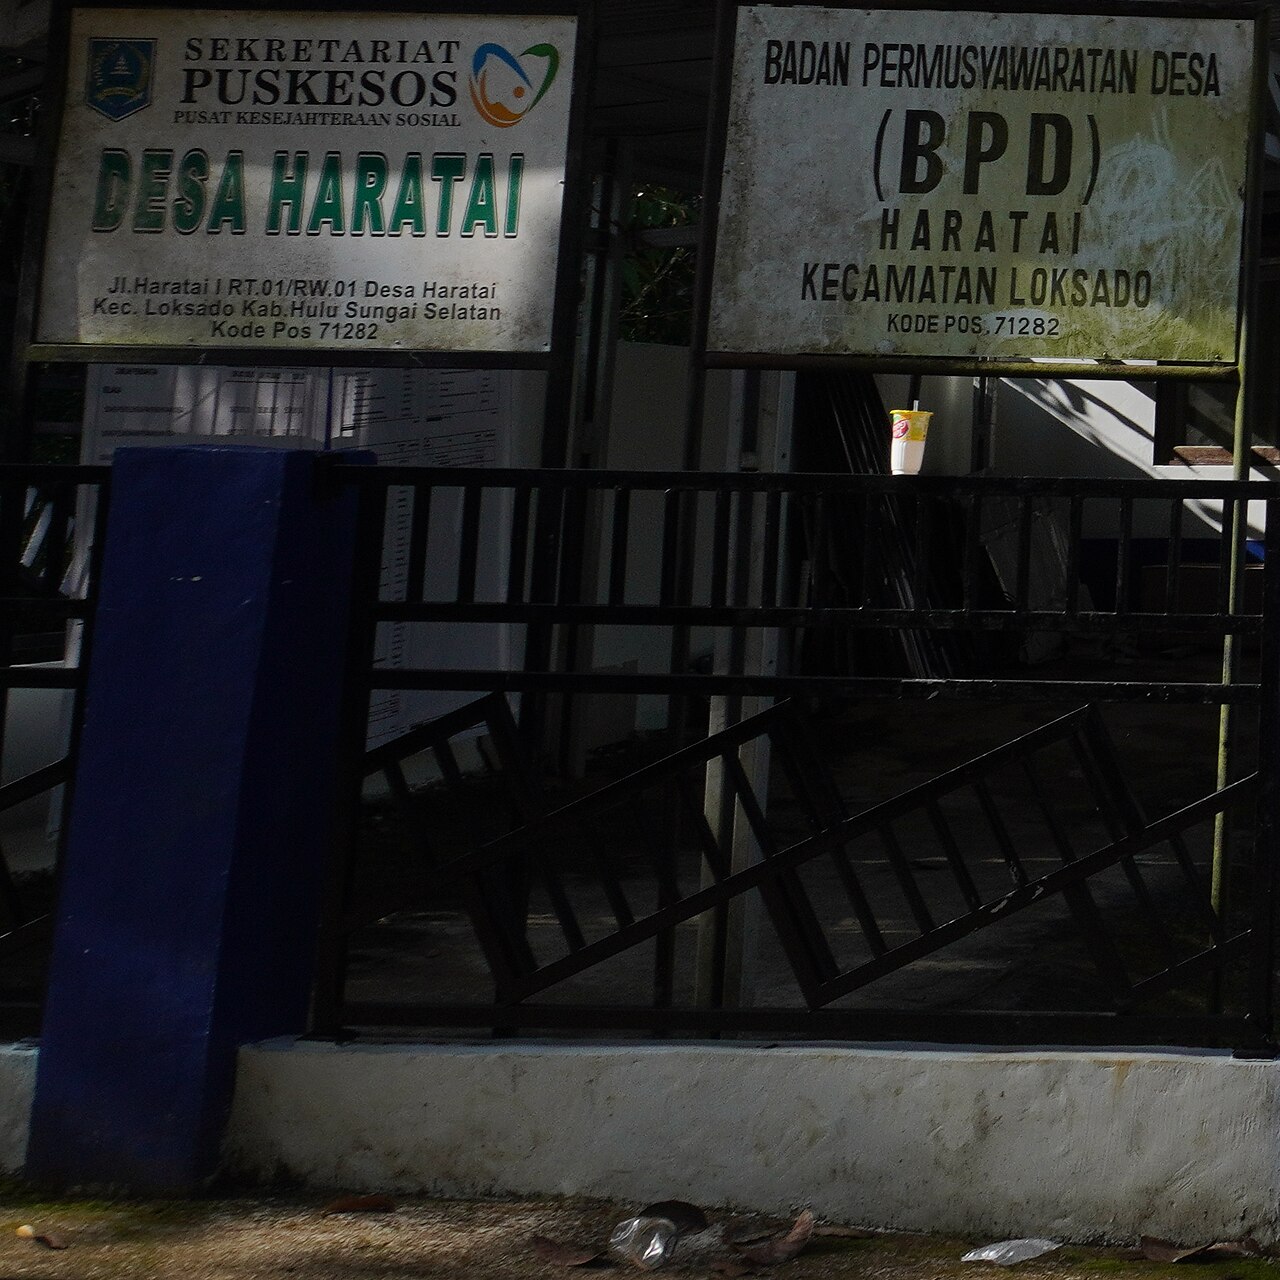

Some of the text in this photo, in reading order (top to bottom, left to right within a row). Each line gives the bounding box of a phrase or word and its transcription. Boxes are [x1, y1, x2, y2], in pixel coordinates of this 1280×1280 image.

[185, 38, 460, 65] SEKRETARIAT
[764, 39, 1220, 97] BADAN PERMUSYAWARATAN DESA
[180, 68, 458, 107] PUSKESOS
[173, 110, 461, 128] PUSAT KESEJAHTERAAN SOSIAL
[873, 109, 1099, 206] (BPD)
[91, 147, 525, 239] DESA HARATAI
[880, 209, 1081, 255] HARATAI
[228, 278, 356, 299] RT.01/RW.01
[364, 280, 415, 299] Desa
[422, 281, 497, 300] Haratai
[801, 263, 1151, 308] KECAMATAN LOKSADO
[92, 297, 501, 323] Kec. Loksado Kab.Hulu Sungai Selatan
[887, 314, 939, 333] KODE
[994, 316, 1060, 336] 71282
[211, 320, 378, 340] Kode Pos 71282
